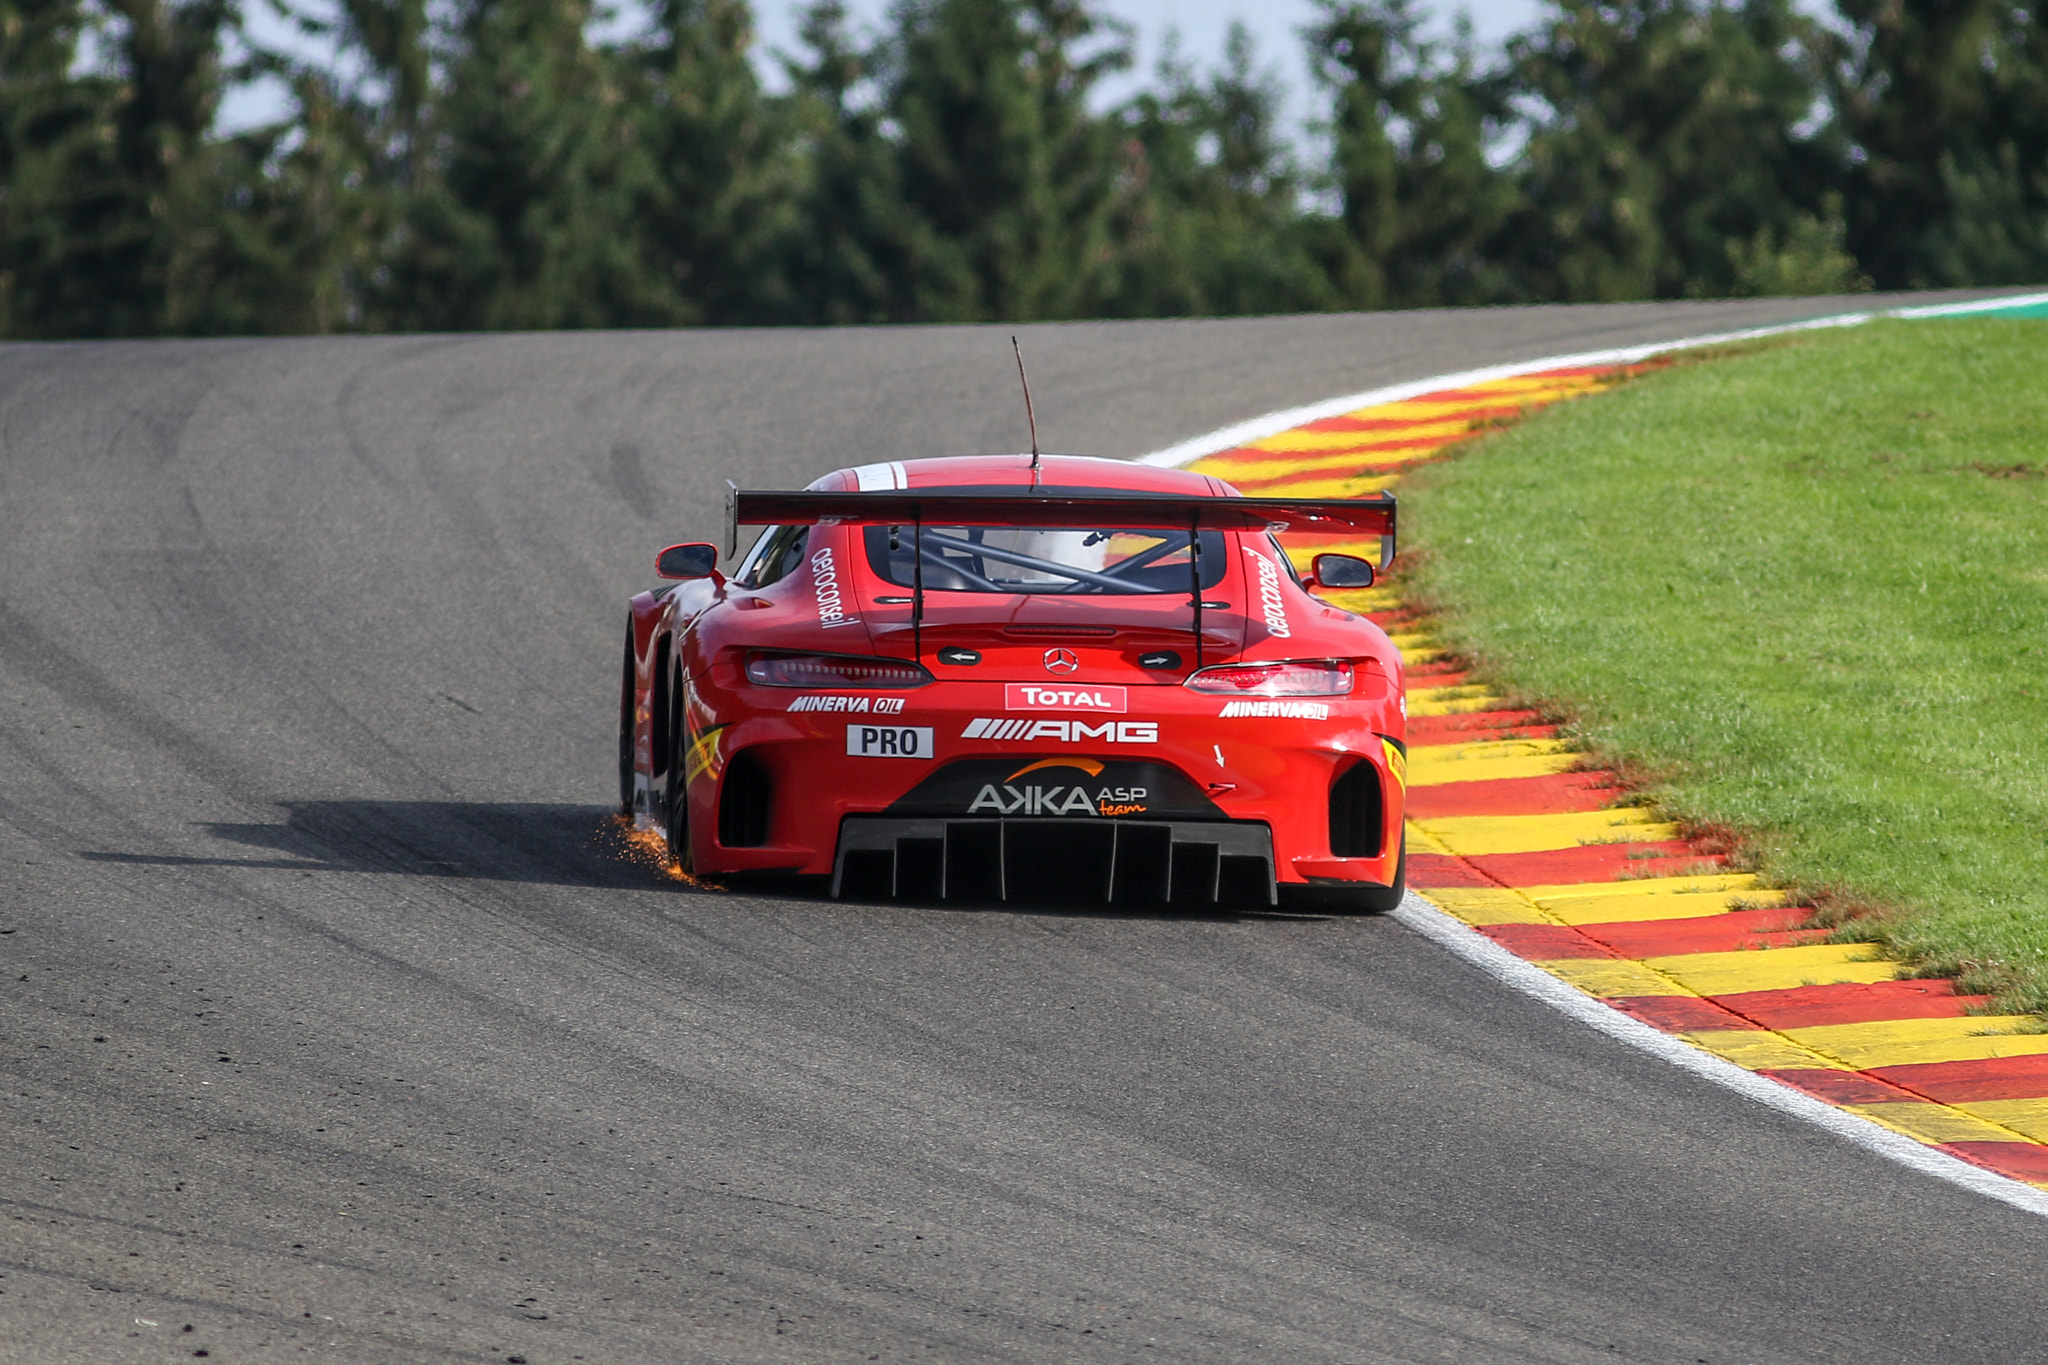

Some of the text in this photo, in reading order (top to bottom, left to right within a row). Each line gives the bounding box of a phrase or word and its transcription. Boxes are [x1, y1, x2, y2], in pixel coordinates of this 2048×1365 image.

[811, 547, 860, 629] aeroconseil
[1242, 546, 1291, 638] aeroconseil
[786, 696, 904, 714] MINERVA OIL
[1021, 687, 1112, 708] TOTAL
[1219, 702, 1329, 720] MINERVA OIL
[861, 727, 918, 756] PRO
[967, 784, 1147, 816] AKKA ASP
[1099, 799, 1147, 817] team
